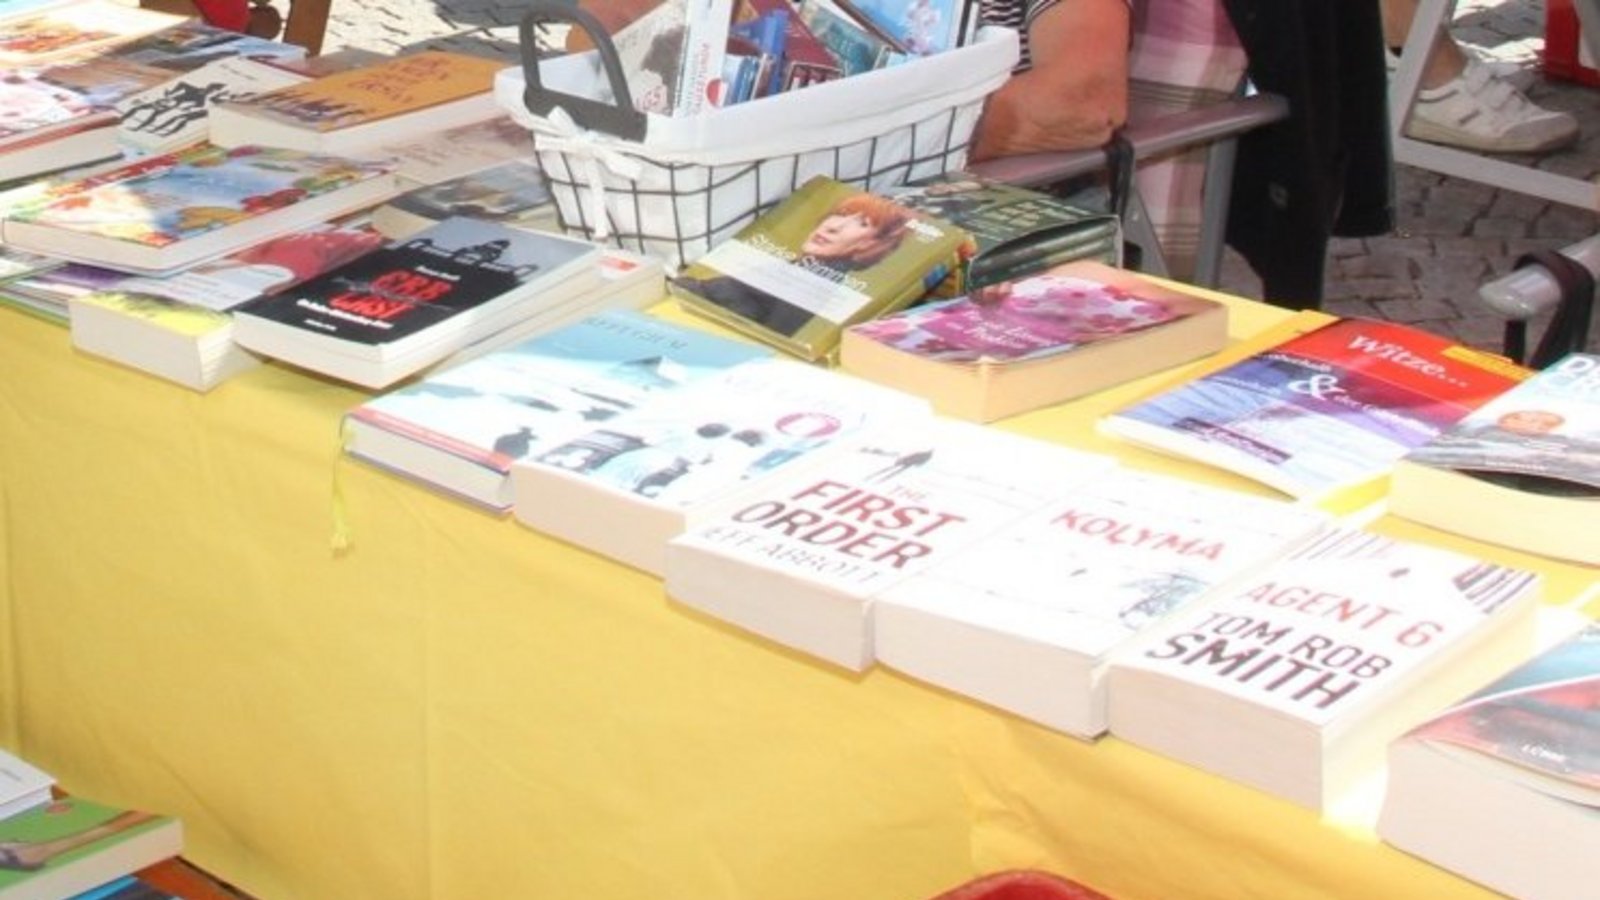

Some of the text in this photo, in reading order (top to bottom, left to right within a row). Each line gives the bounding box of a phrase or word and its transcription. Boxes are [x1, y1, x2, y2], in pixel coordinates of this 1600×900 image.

[1287, 373, 1347, 401] &
[731, 500, 933, 569] ORDER
[790, 479, 968, 537] FIRST
[1049, 509, 1226, 561] KOLYMA
[1191, 612, 1393, 679] TOM ROB
[1237, 581, 1444, 648] AGENT 6
[1144, 632, 1361, 709] SMITH
